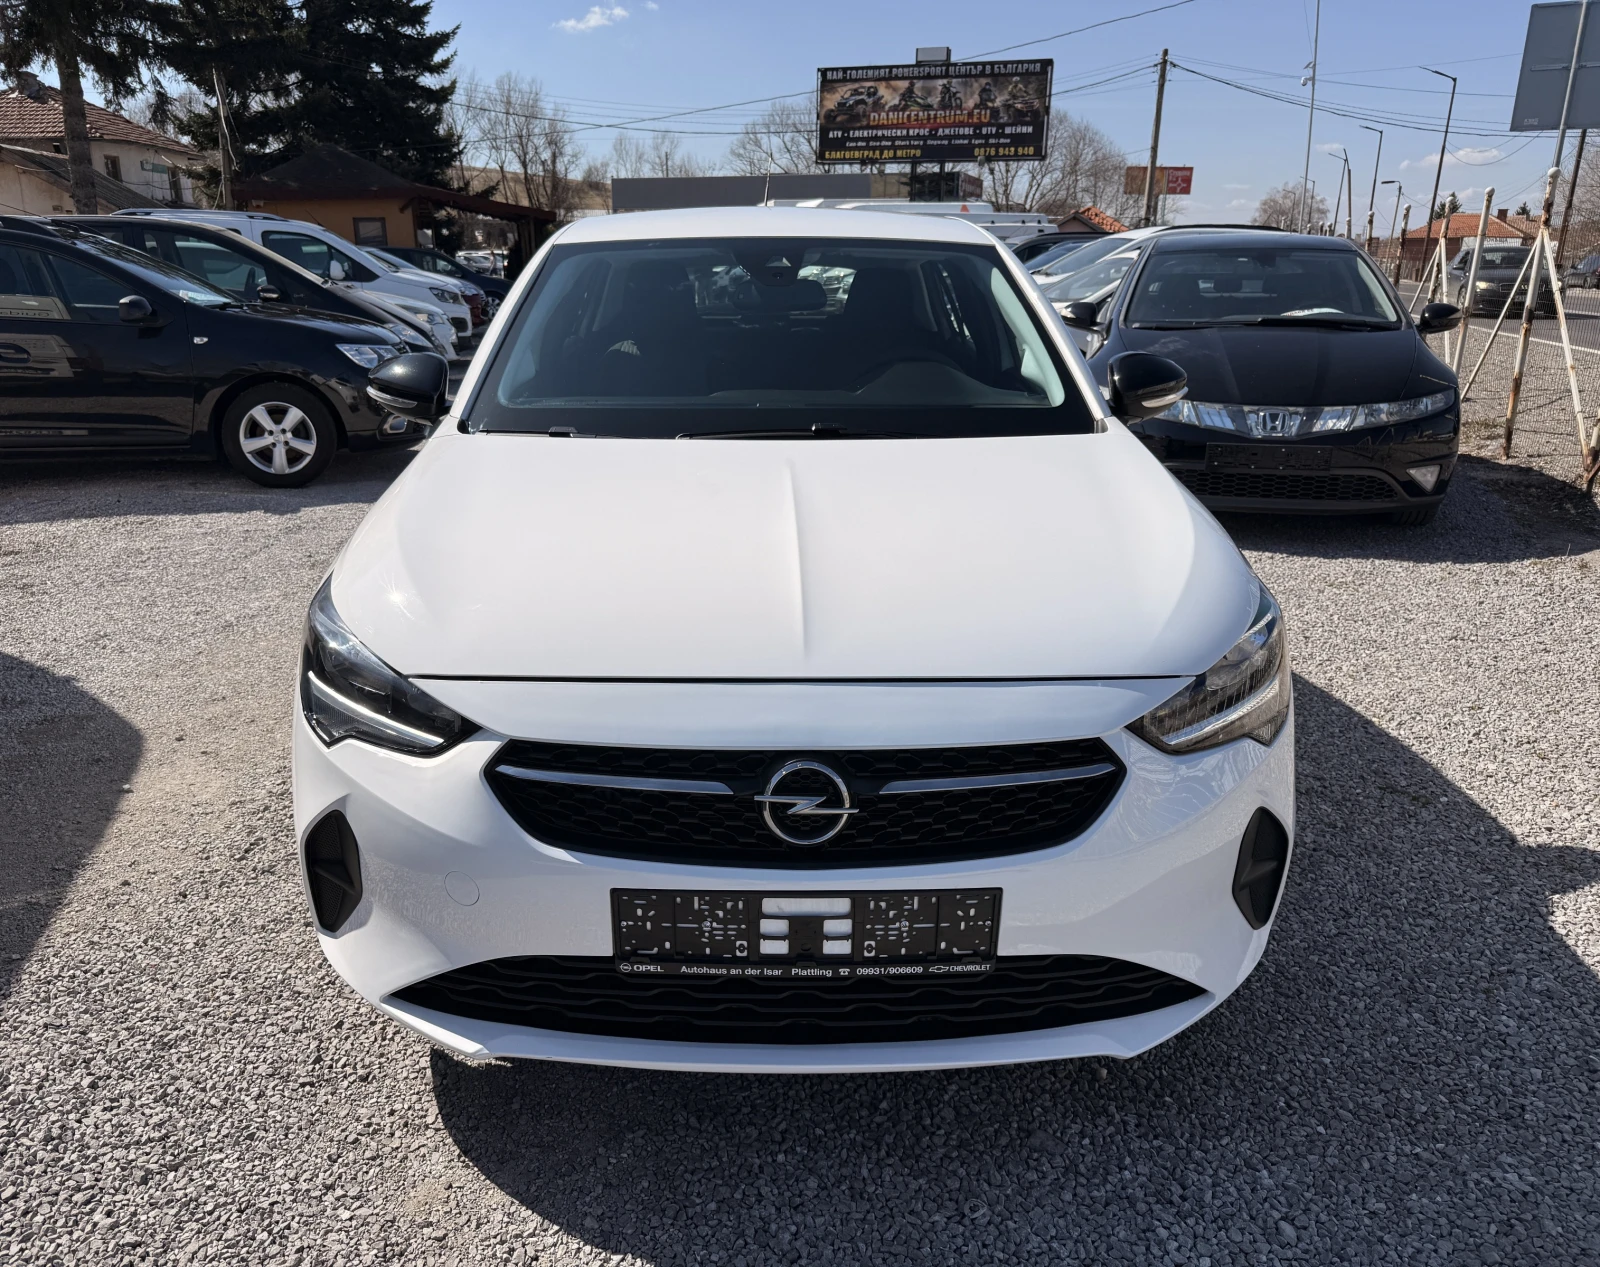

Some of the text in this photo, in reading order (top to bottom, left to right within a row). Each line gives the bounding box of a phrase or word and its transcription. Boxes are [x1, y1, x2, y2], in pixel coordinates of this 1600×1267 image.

[826, 63, 1041, 80] НАЙ-ГОЛЕМИЯТ POWERSPORT ЦЕНТЪР В БЪЛГАРИЯ
[870, 109, 990, 125] DANICENTRUM.EU
[828, 125, 1034, 138] ATV ЕЛЕКТРИЧЕСКИ КРОС ДЖЕТОВЕ UTV ШЕЙНИ
[825, 149, 921, 159] БЛАГОЕВГРАД ДО МЕТРО
[974, 146, 1035, 156] 0876 943 940
[681, 965, 727, 975] Autohaus
[729, 967, 743, 975] an
[745, 967, 762, 975] der
[791, 968, 833, 977] Plattling
[856, 966, 924, 976] 09931/906609
[950, 964, 991, 972] CHEVROLET
